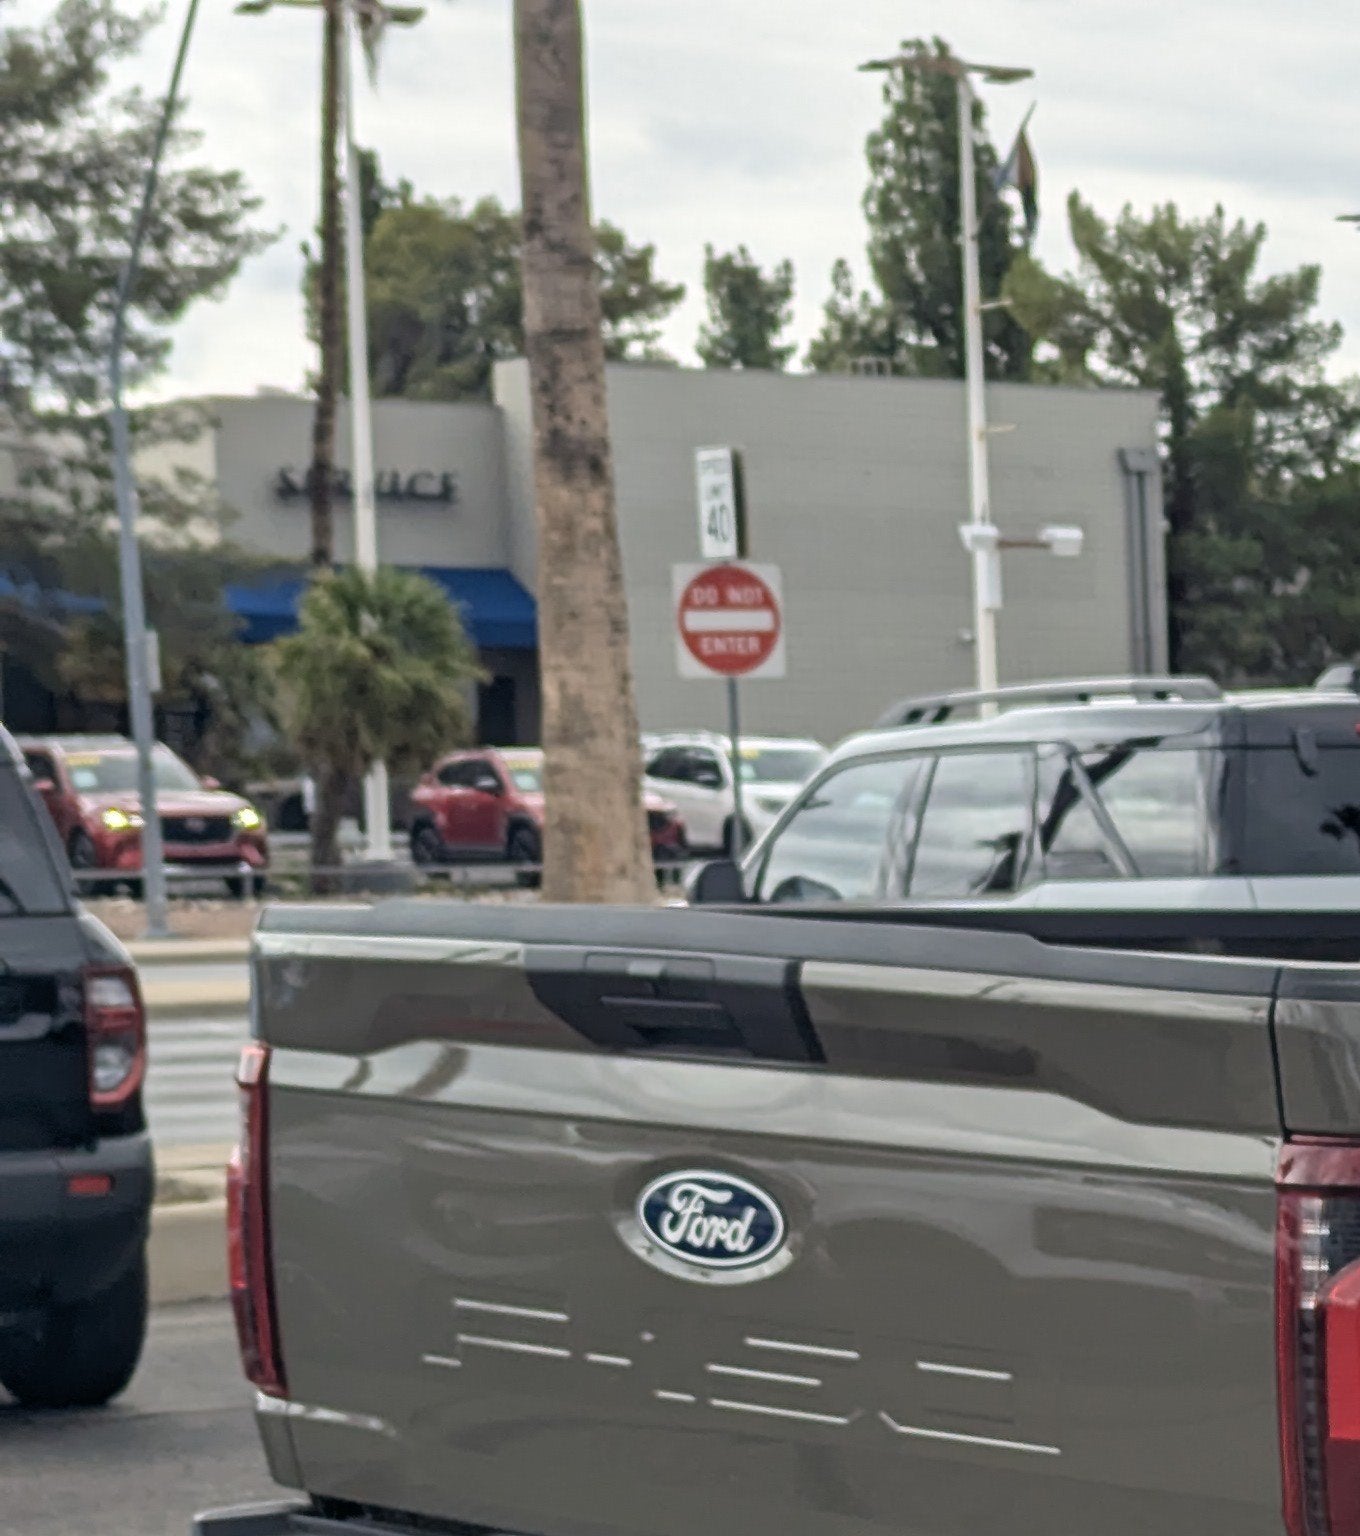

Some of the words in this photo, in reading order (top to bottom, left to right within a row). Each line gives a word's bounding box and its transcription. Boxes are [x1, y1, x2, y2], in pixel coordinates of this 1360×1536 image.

[692, 586, 718, 605] DO
[727, 587, 764, 604] NOT
[701, 636, 761, 656] ENTER
[659, 1182, 757, 1253] Ford
